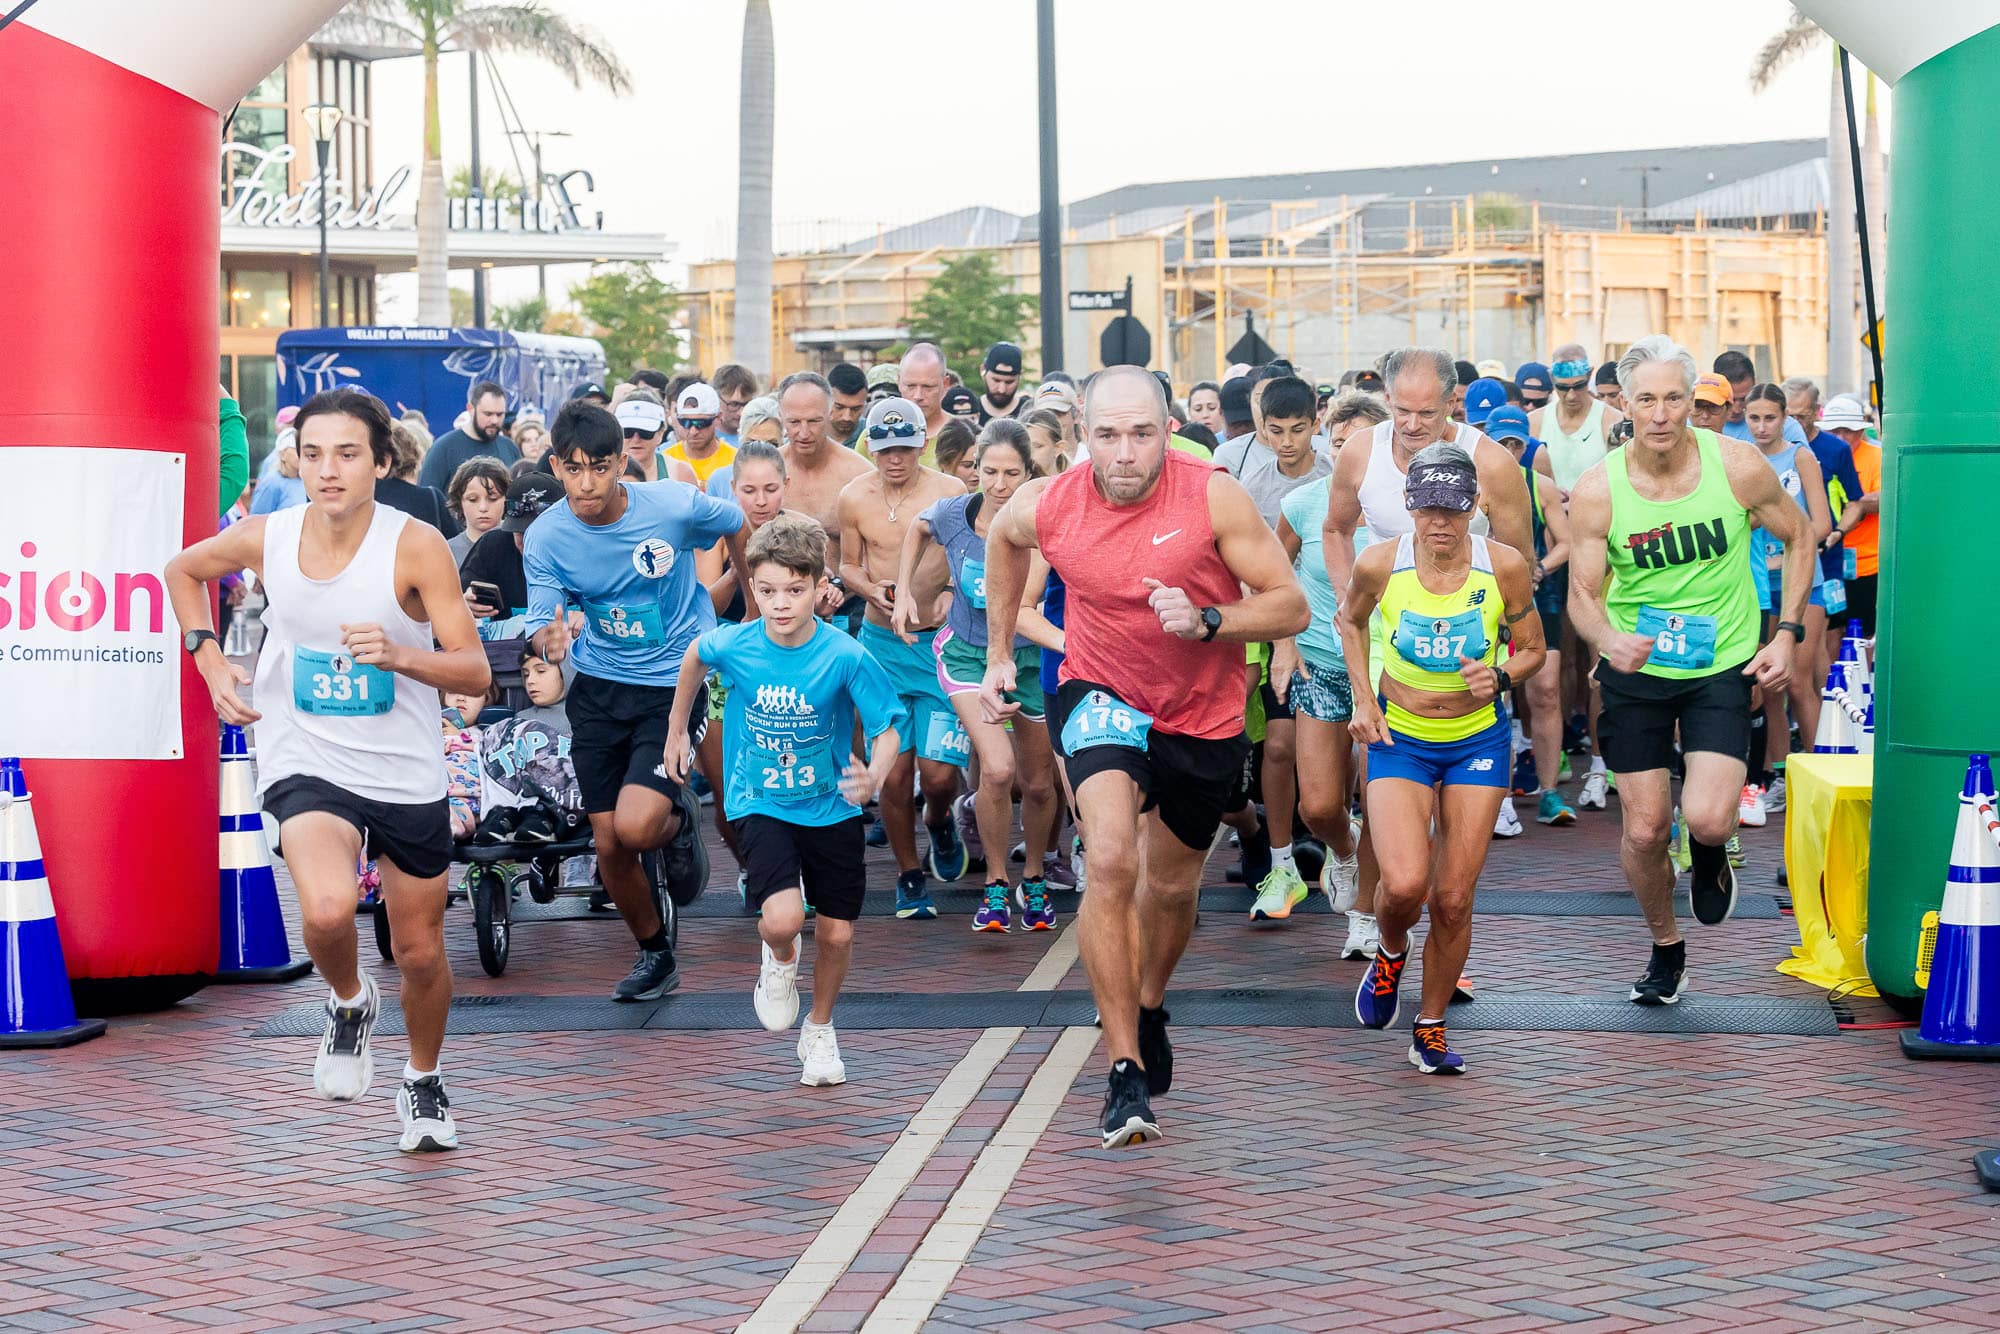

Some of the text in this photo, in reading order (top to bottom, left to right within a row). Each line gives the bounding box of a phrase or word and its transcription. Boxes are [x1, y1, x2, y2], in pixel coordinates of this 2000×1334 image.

[221, 142, 409, 231] Foxtail
[416, 198, 512, 231] FFEE
[1629, 517, 1728, 569] RUN
[598, 617, 646, 638] 584
[10, 644, 164, 664] Communications
[1414, 635, 1467, 659] 587
[1656, 630, 1687, 655] 61
[312, 673, 369, 700] 331
[774, 721, 791, 729] RUN
[799, 719, 819, 728] ROLL
[1075, 706, 1132, 733] 176
[755, 732, 782, 753] 5K
[762, 765, 816, 788] 213
